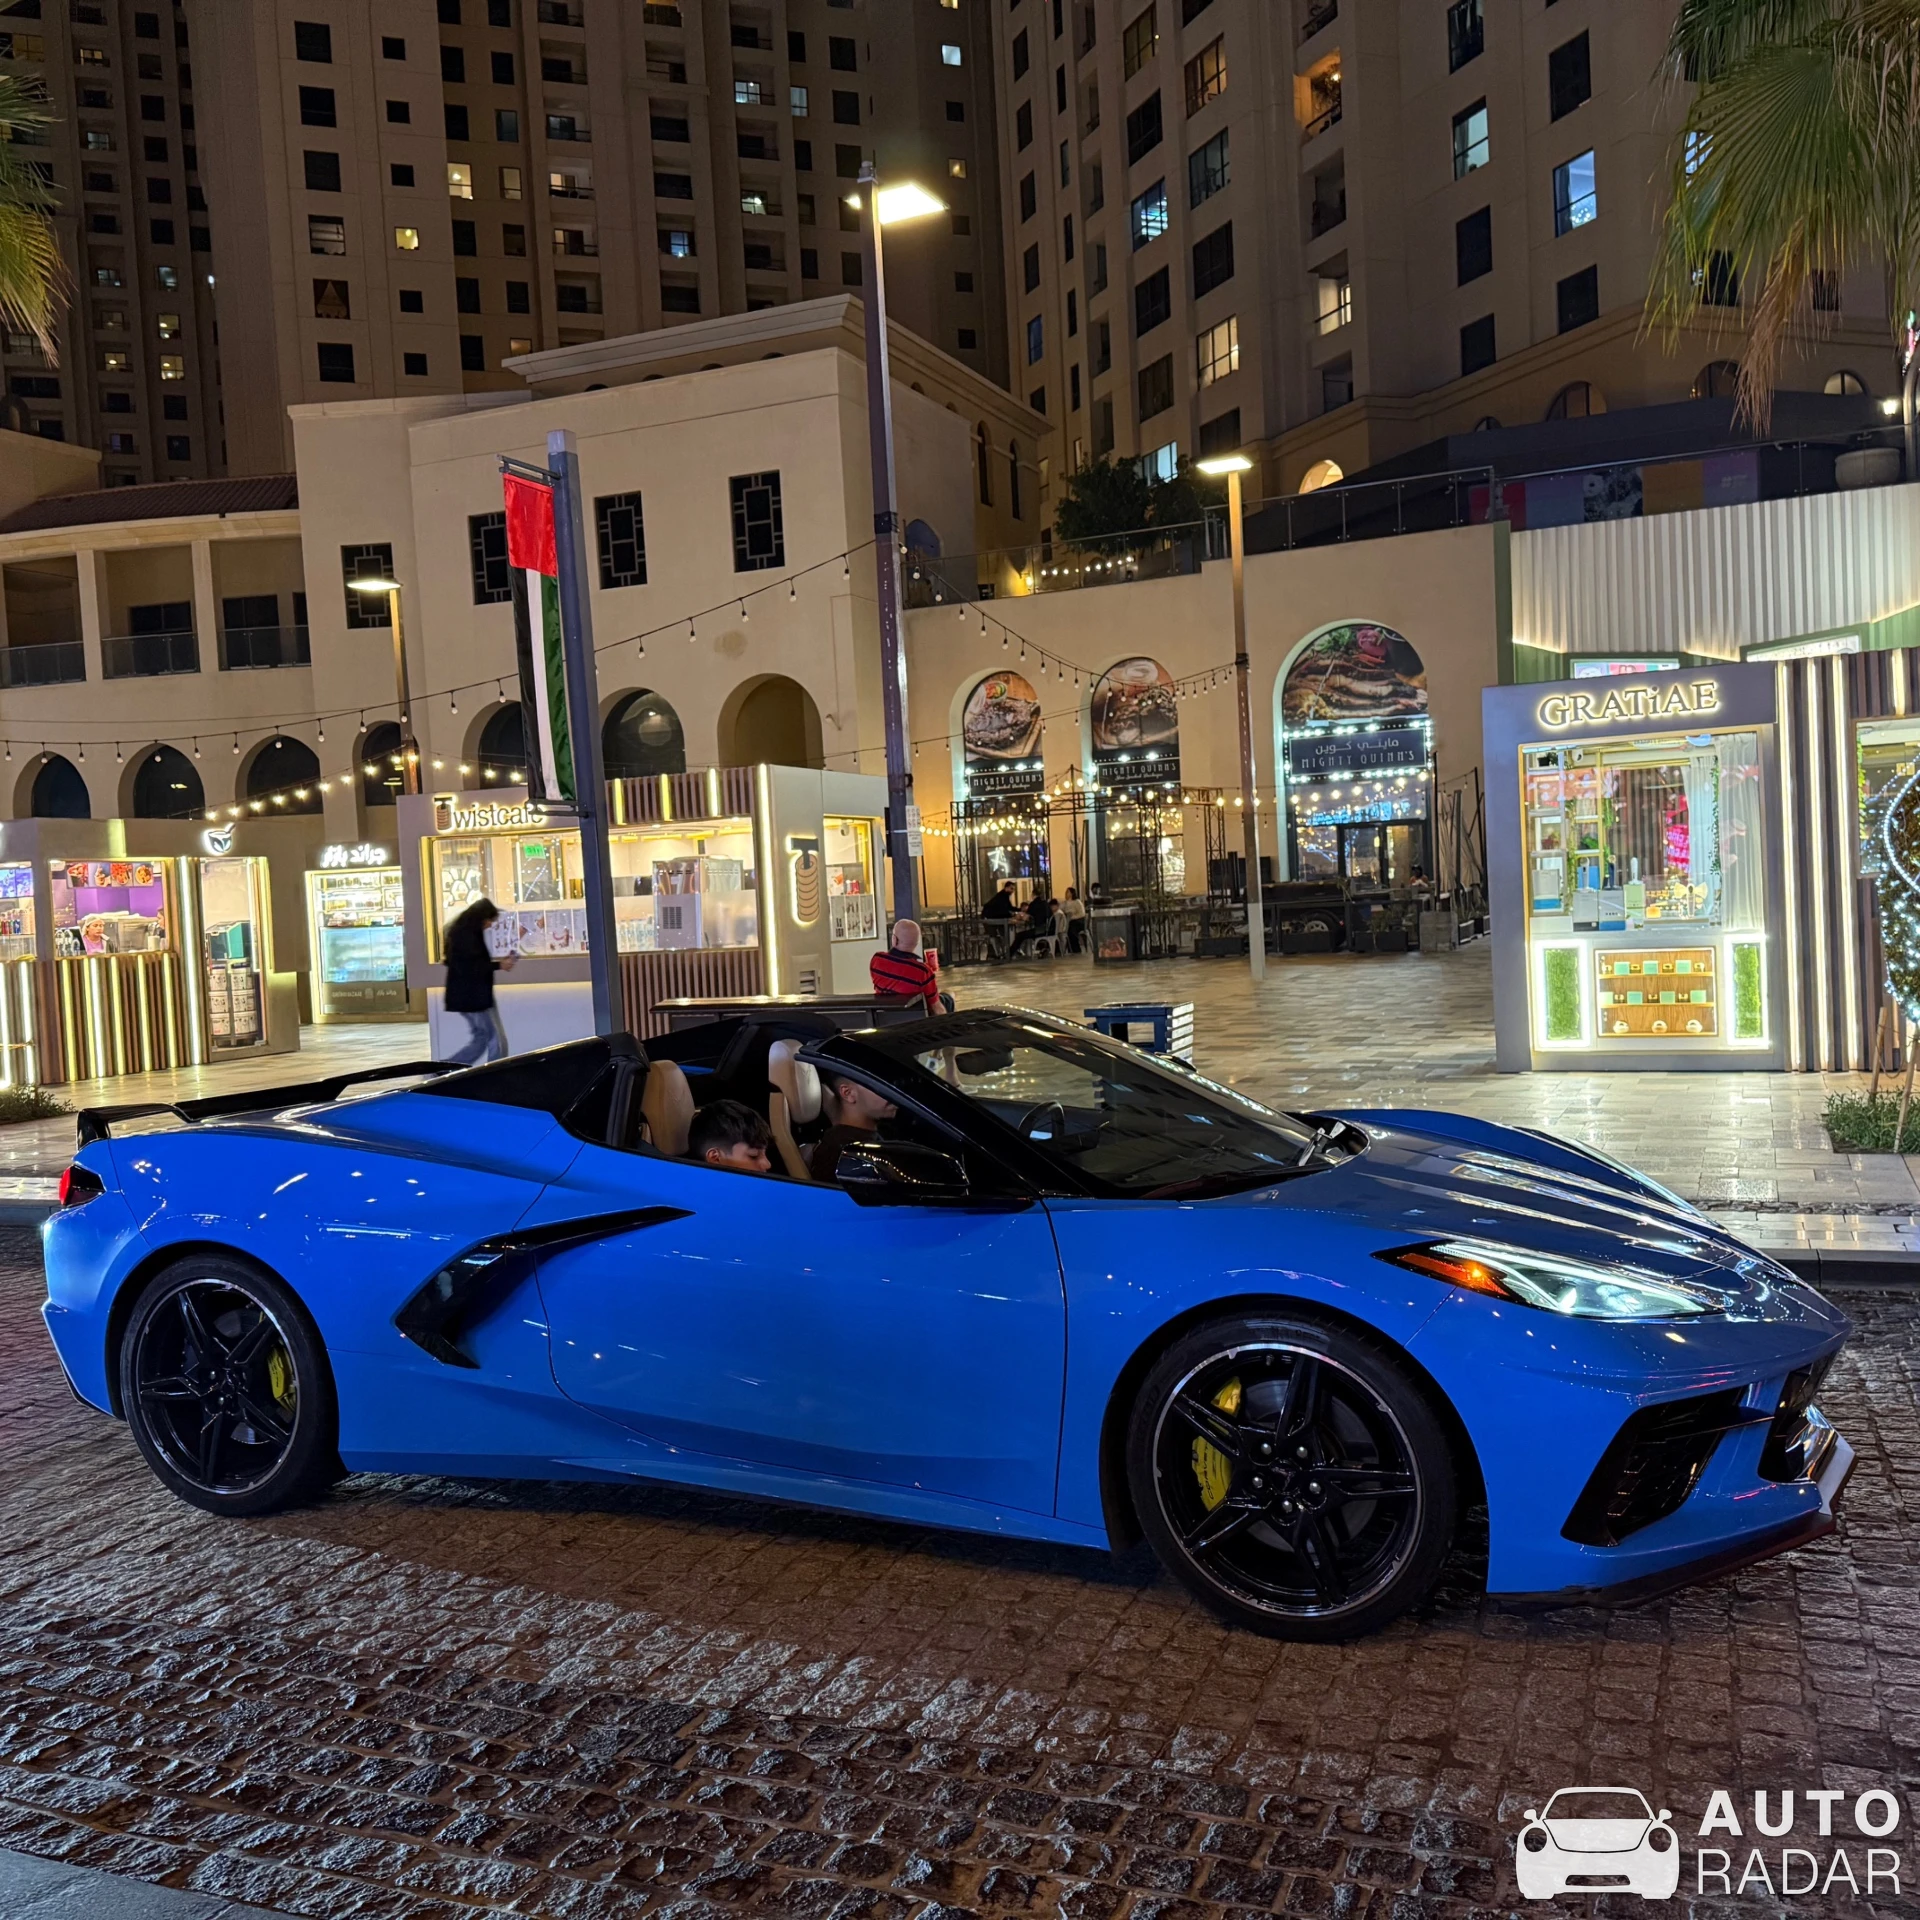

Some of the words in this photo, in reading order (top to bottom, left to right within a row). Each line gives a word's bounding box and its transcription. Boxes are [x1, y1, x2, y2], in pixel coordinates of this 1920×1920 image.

[1301, 755, 1351, 769] MIGHTY
[1360, 750, 1415, 764] QUINN'S
[1202, 1441, 1214, 1500] CORVET
